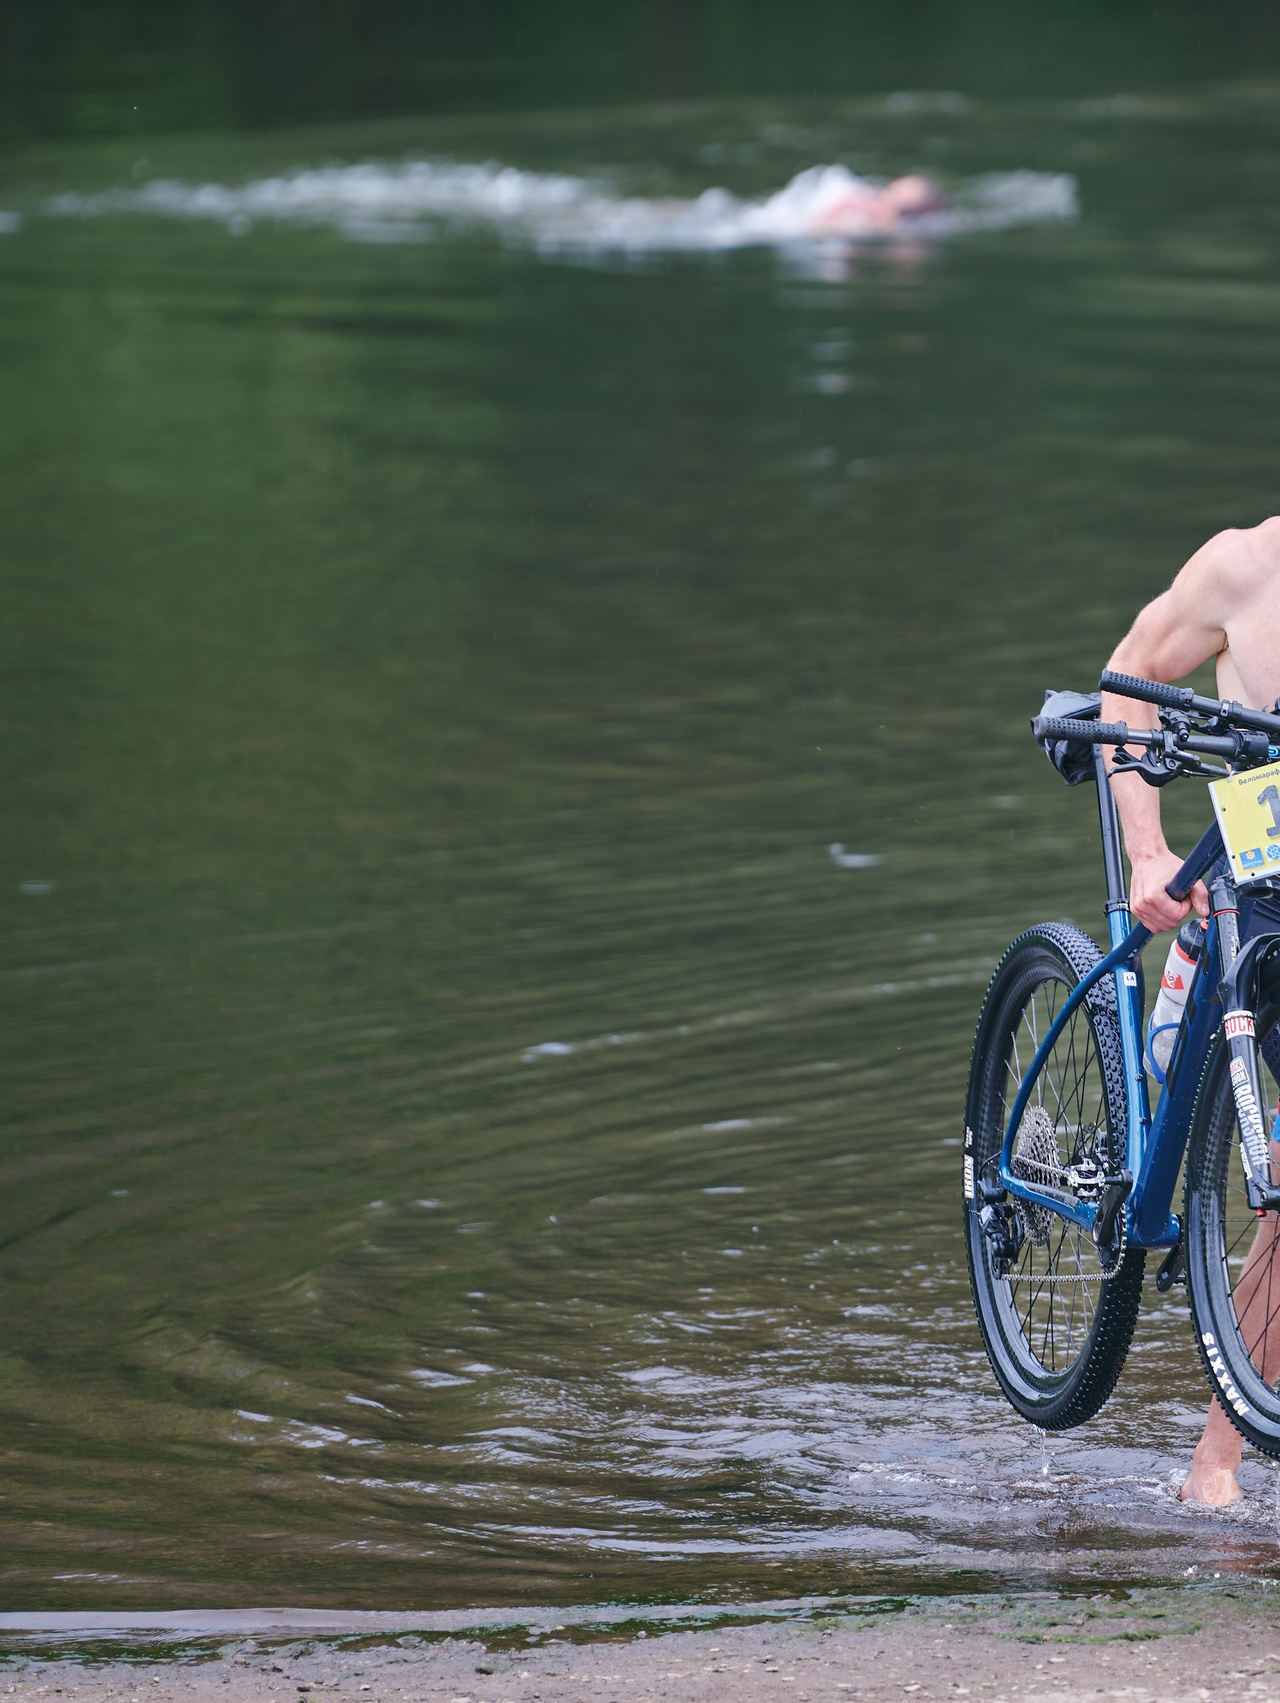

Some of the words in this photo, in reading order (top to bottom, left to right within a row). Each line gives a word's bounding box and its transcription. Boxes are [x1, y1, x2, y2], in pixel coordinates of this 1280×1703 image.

[1233, 1083, 1271, 1167] ROCKSHOX
[964, 1153, 975, 1199] IKON
[1201, 1331, 1251, 1417] MAXXIS
